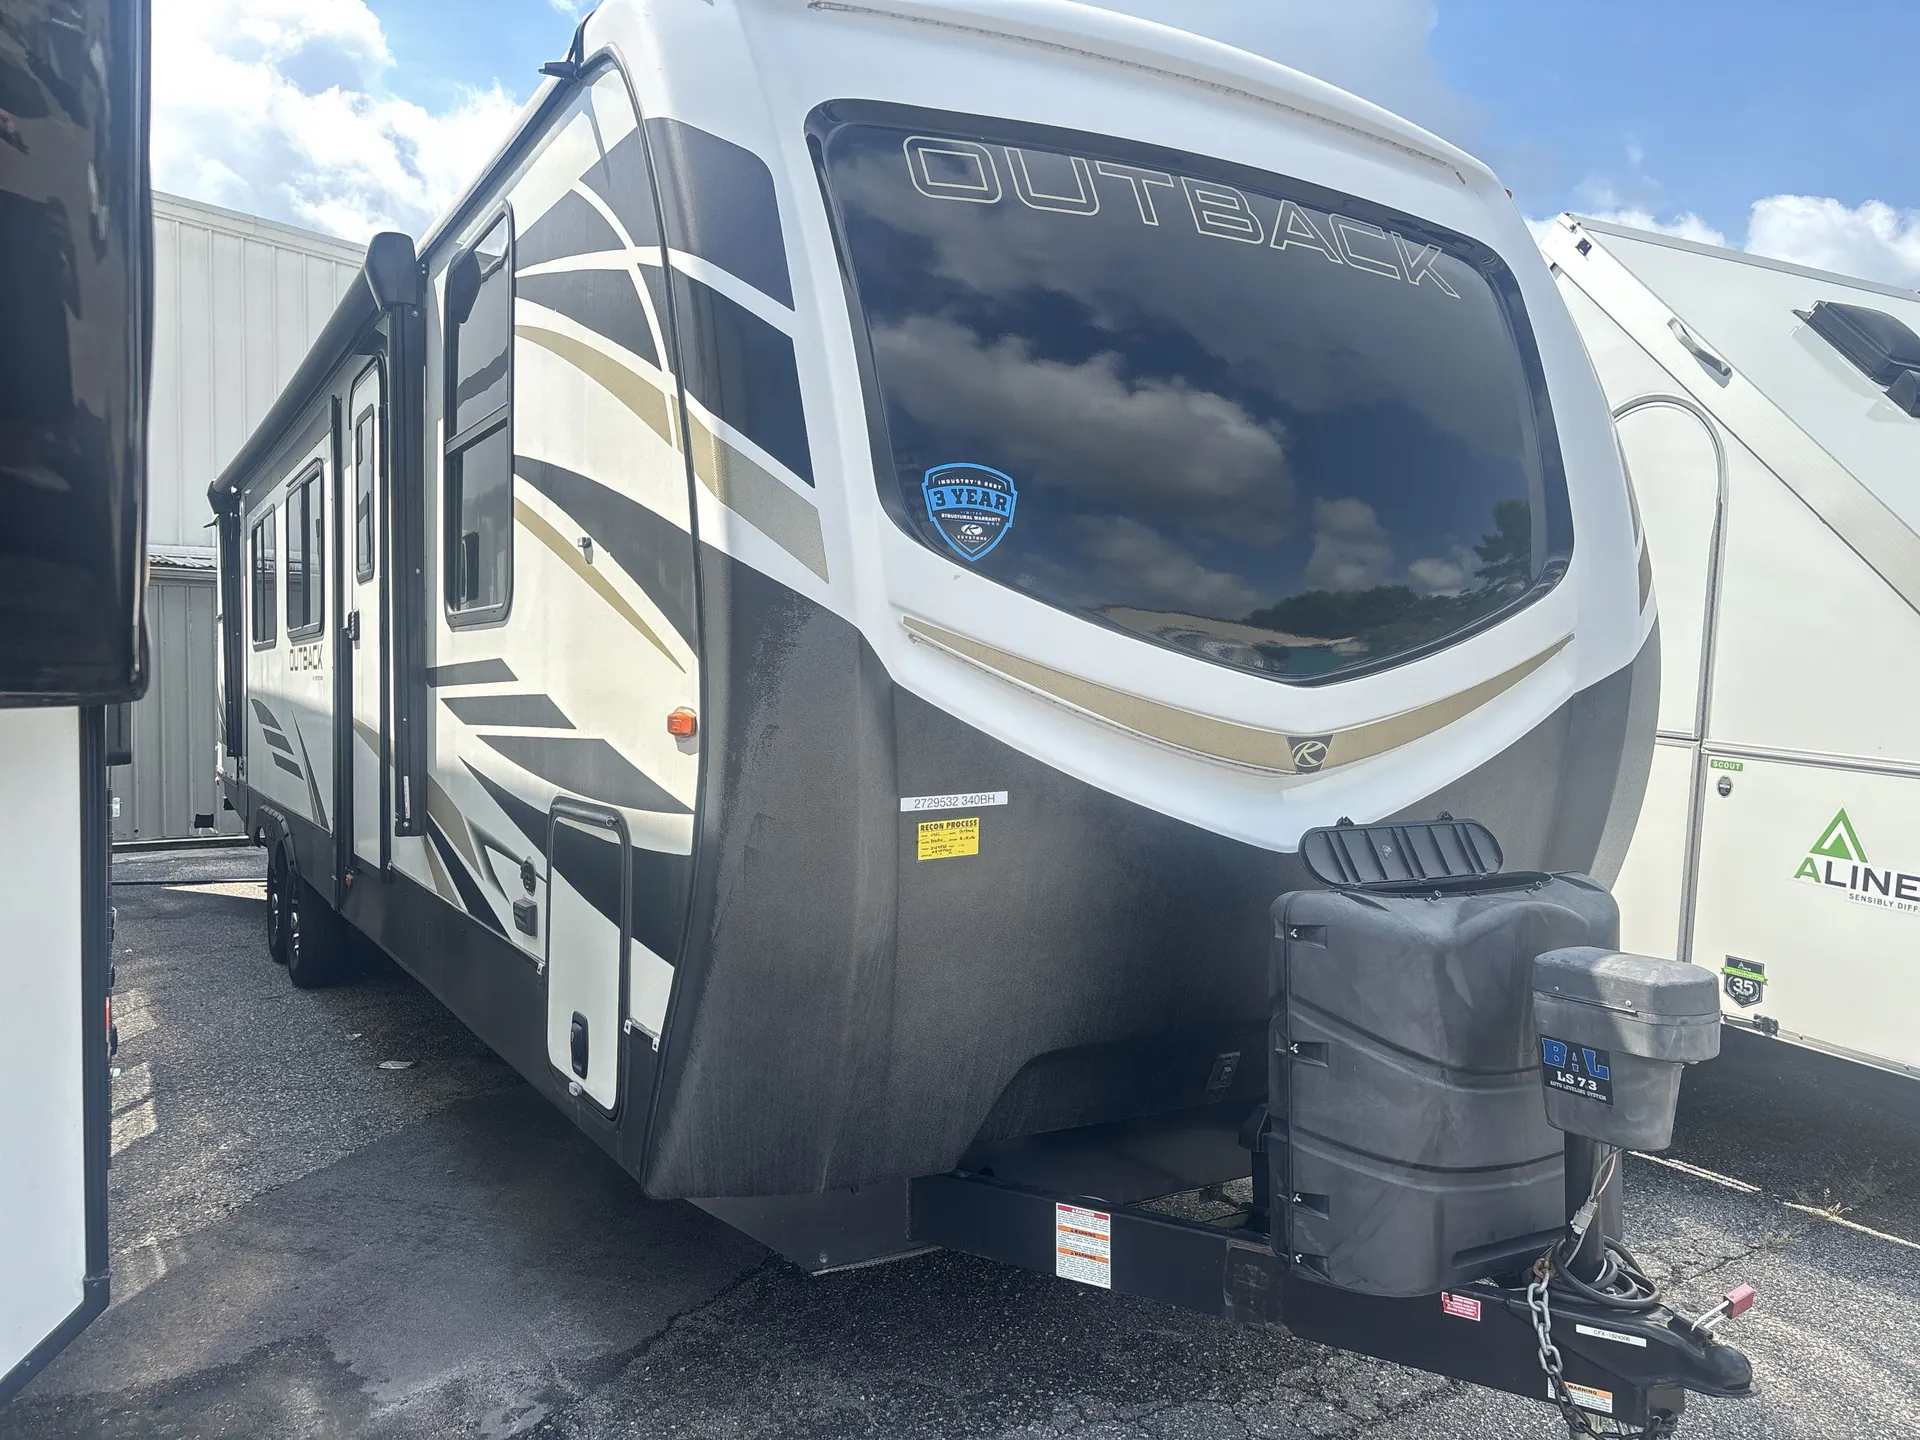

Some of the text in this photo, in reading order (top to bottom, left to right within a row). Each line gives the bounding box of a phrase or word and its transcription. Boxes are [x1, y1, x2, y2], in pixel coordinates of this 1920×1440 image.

[903, 136, 1461, 299] OUTBACK
[984, 481, 1002, 490] BEST
[933, 488, 1008, 512] 3 YEAR
[289, 644, 323, 671] OUTBACK
[1712, 760, 1741, 770] SCOUT
[914, 794, 996, 809] 2729532 340BH
[920, 819, 978, 831] RECON PROCESS
[1849, 892, 1920, 913] SENSIBLY DIFF
[1733, 977, 1754, 995] 35
[1556, 1070, 1575, 1085] LS
[1562, 1083, 1586, 1095] LEVELING
[1586, 1090, 1607, 1101] SYSTEM
[1567, 1383, 1598, 1396] WARNING
